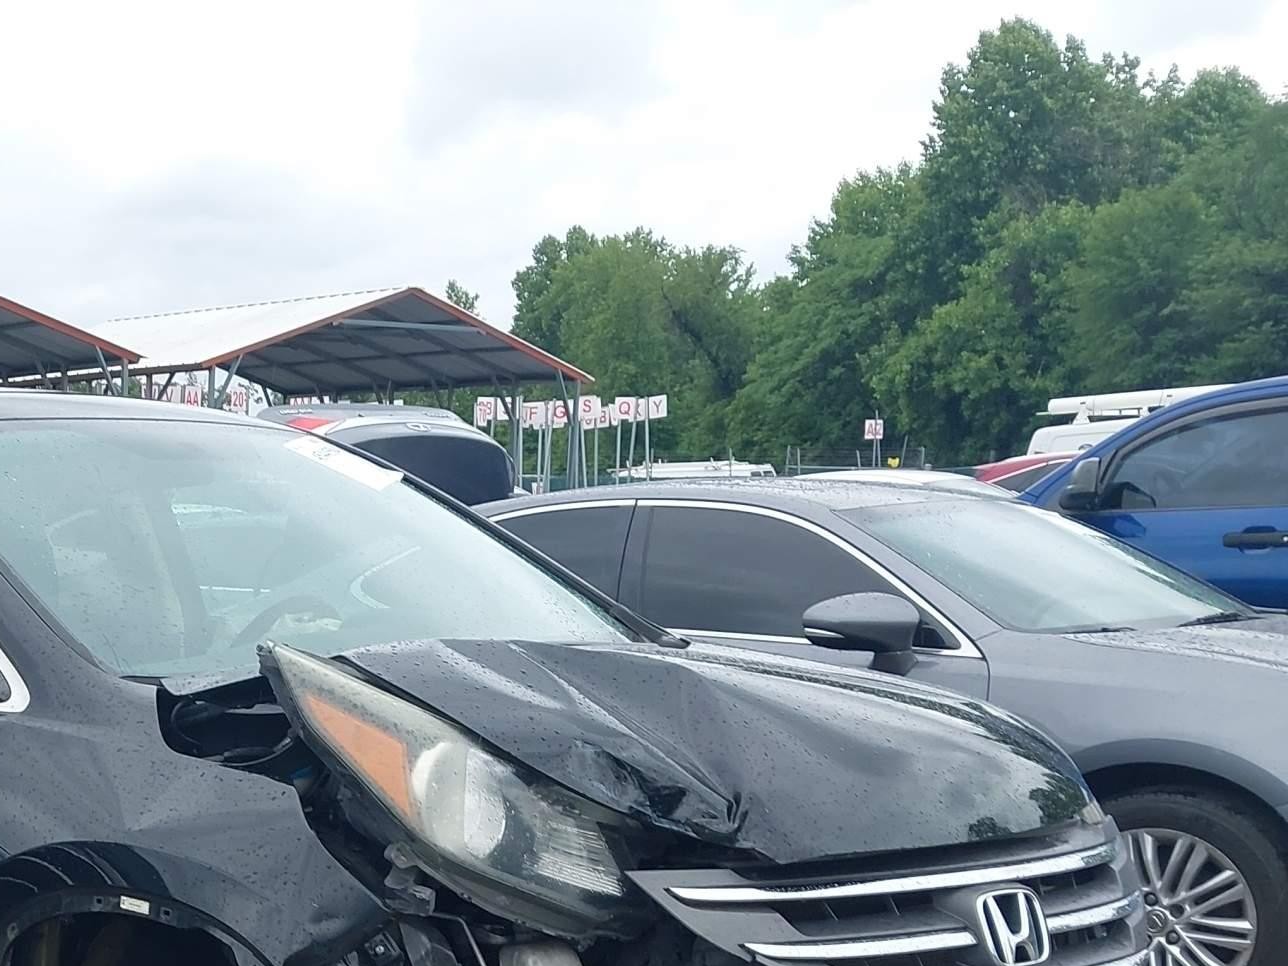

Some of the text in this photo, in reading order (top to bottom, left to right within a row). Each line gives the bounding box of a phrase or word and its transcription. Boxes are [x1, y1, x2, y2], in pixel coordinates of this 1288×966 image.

[187, 390, 199, 406] AA
[232, 391, 244, 408] 20
[529, 406, 538, 420] F
[553, 405, 568, 419] G
[582, 399, 592, 413] S
[618, 401, 631, 416] Q
[653, 400, 663, 414] Y
